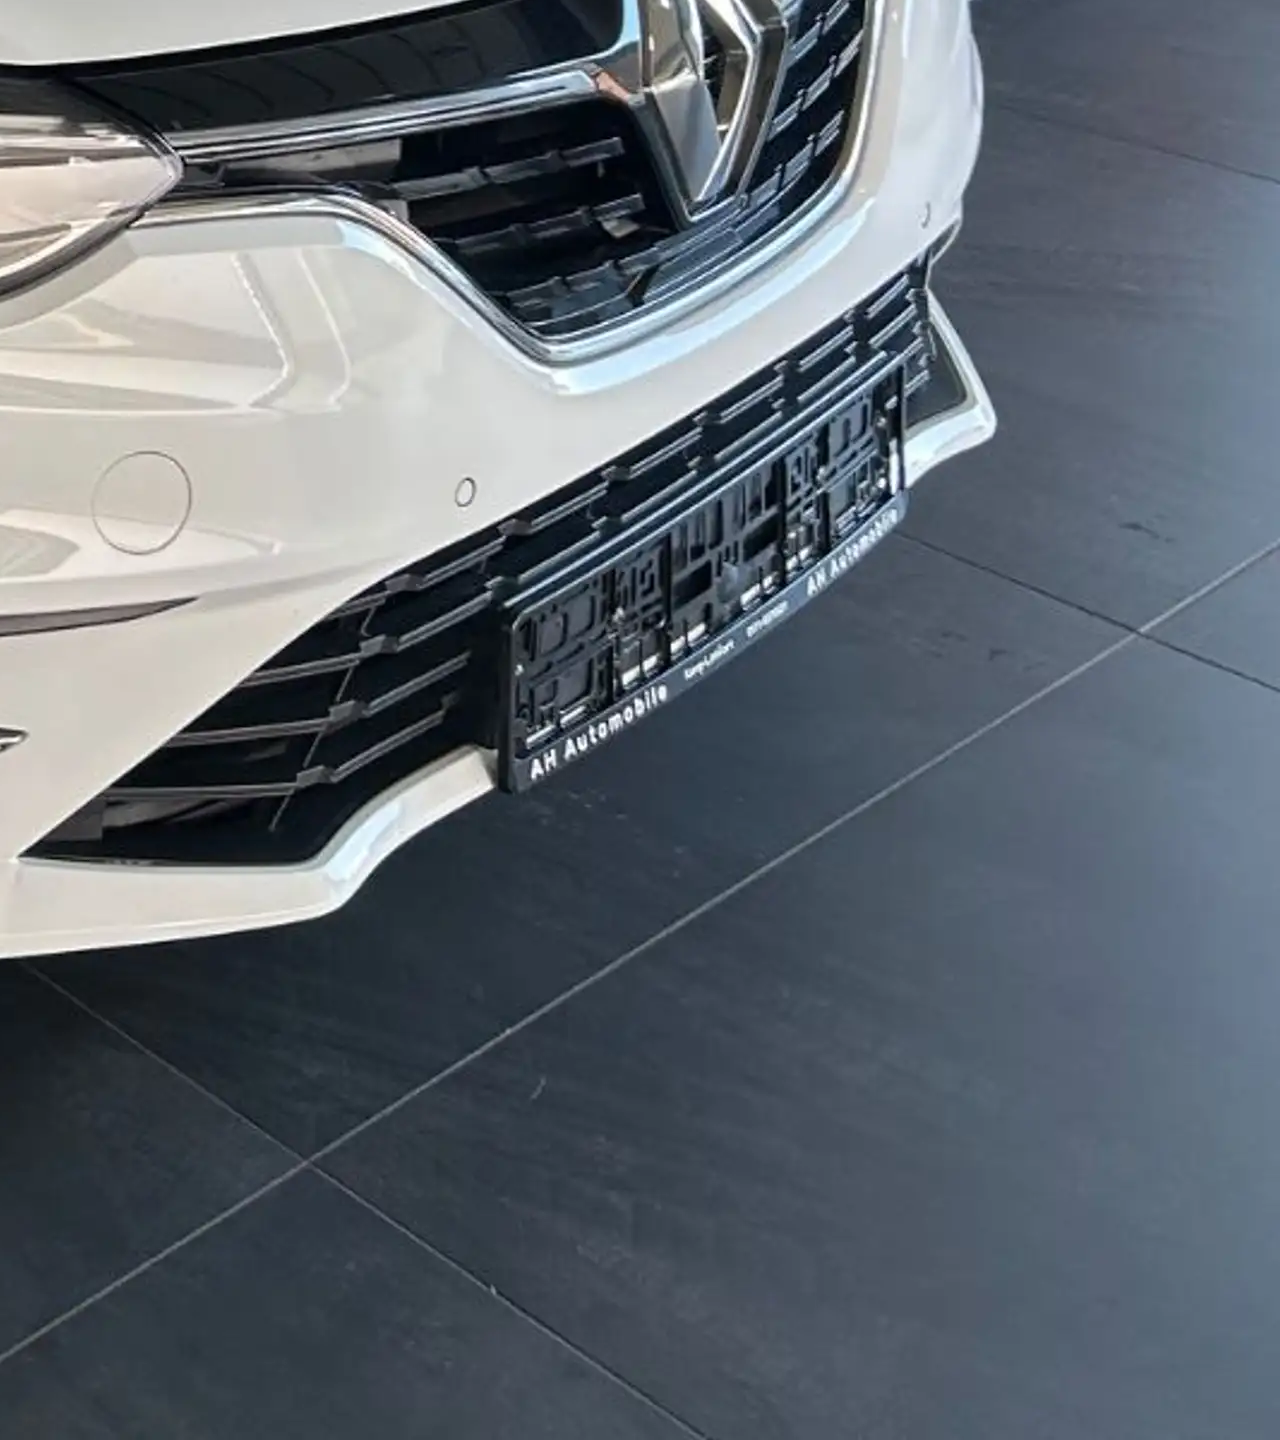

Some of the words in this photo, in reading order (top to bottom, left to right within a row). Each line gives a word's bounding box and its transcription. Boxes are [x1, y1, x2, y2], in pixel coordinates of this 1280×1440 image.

[531, 748, 557, 781] AH
[563, 684, 668, 761] Automobile
[807, 566, 827, 597] AH
